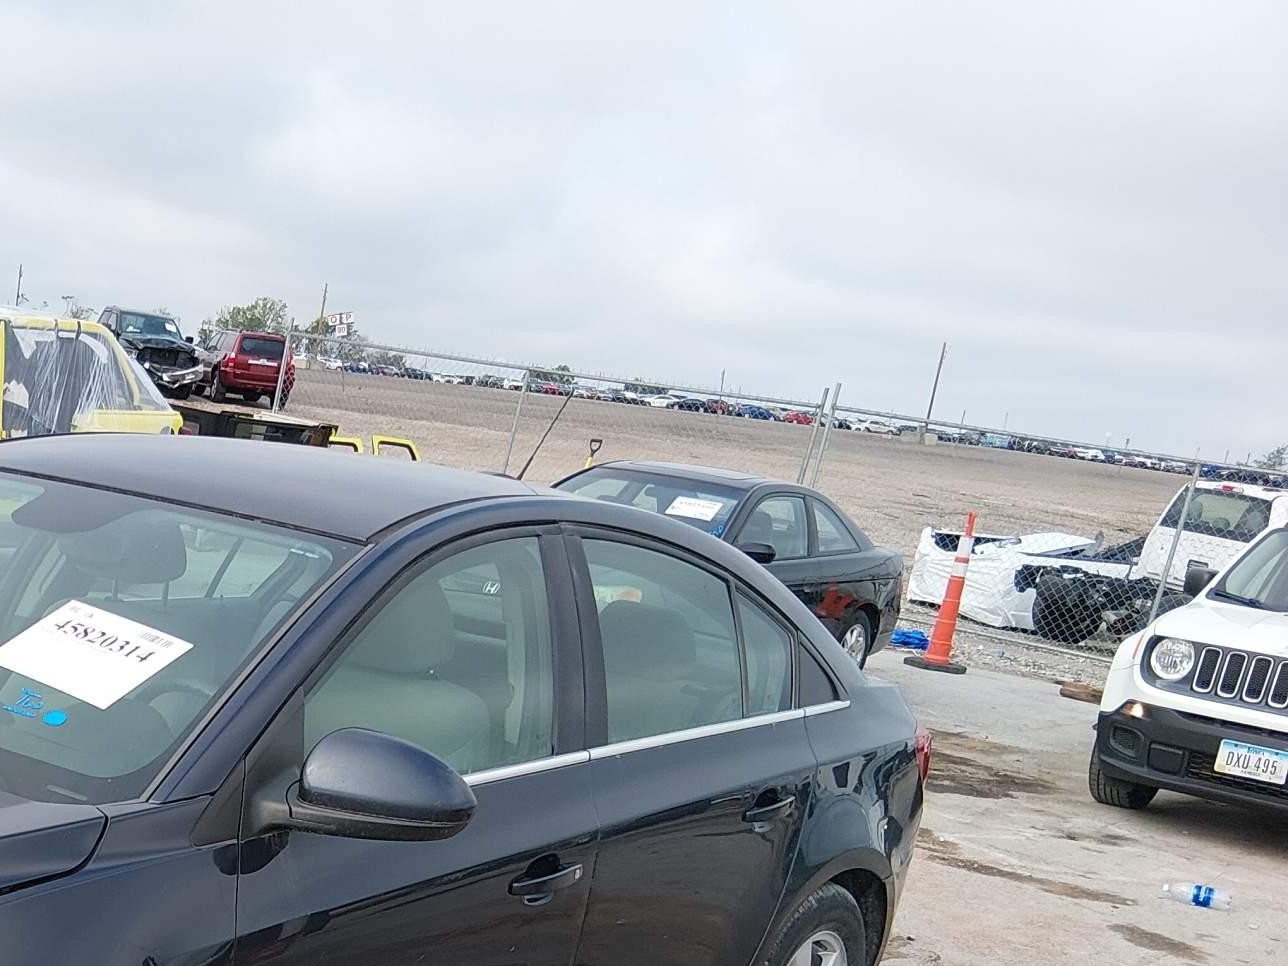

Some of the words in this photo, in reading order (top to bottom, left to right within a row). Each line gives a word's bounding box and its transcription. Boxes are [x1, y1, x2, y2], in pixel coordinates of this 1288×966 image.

[54, 618, 157, 664] 45820314
[1225, 751, 1251, 770] DXU
[1254, 757, 1279, 776] 495
